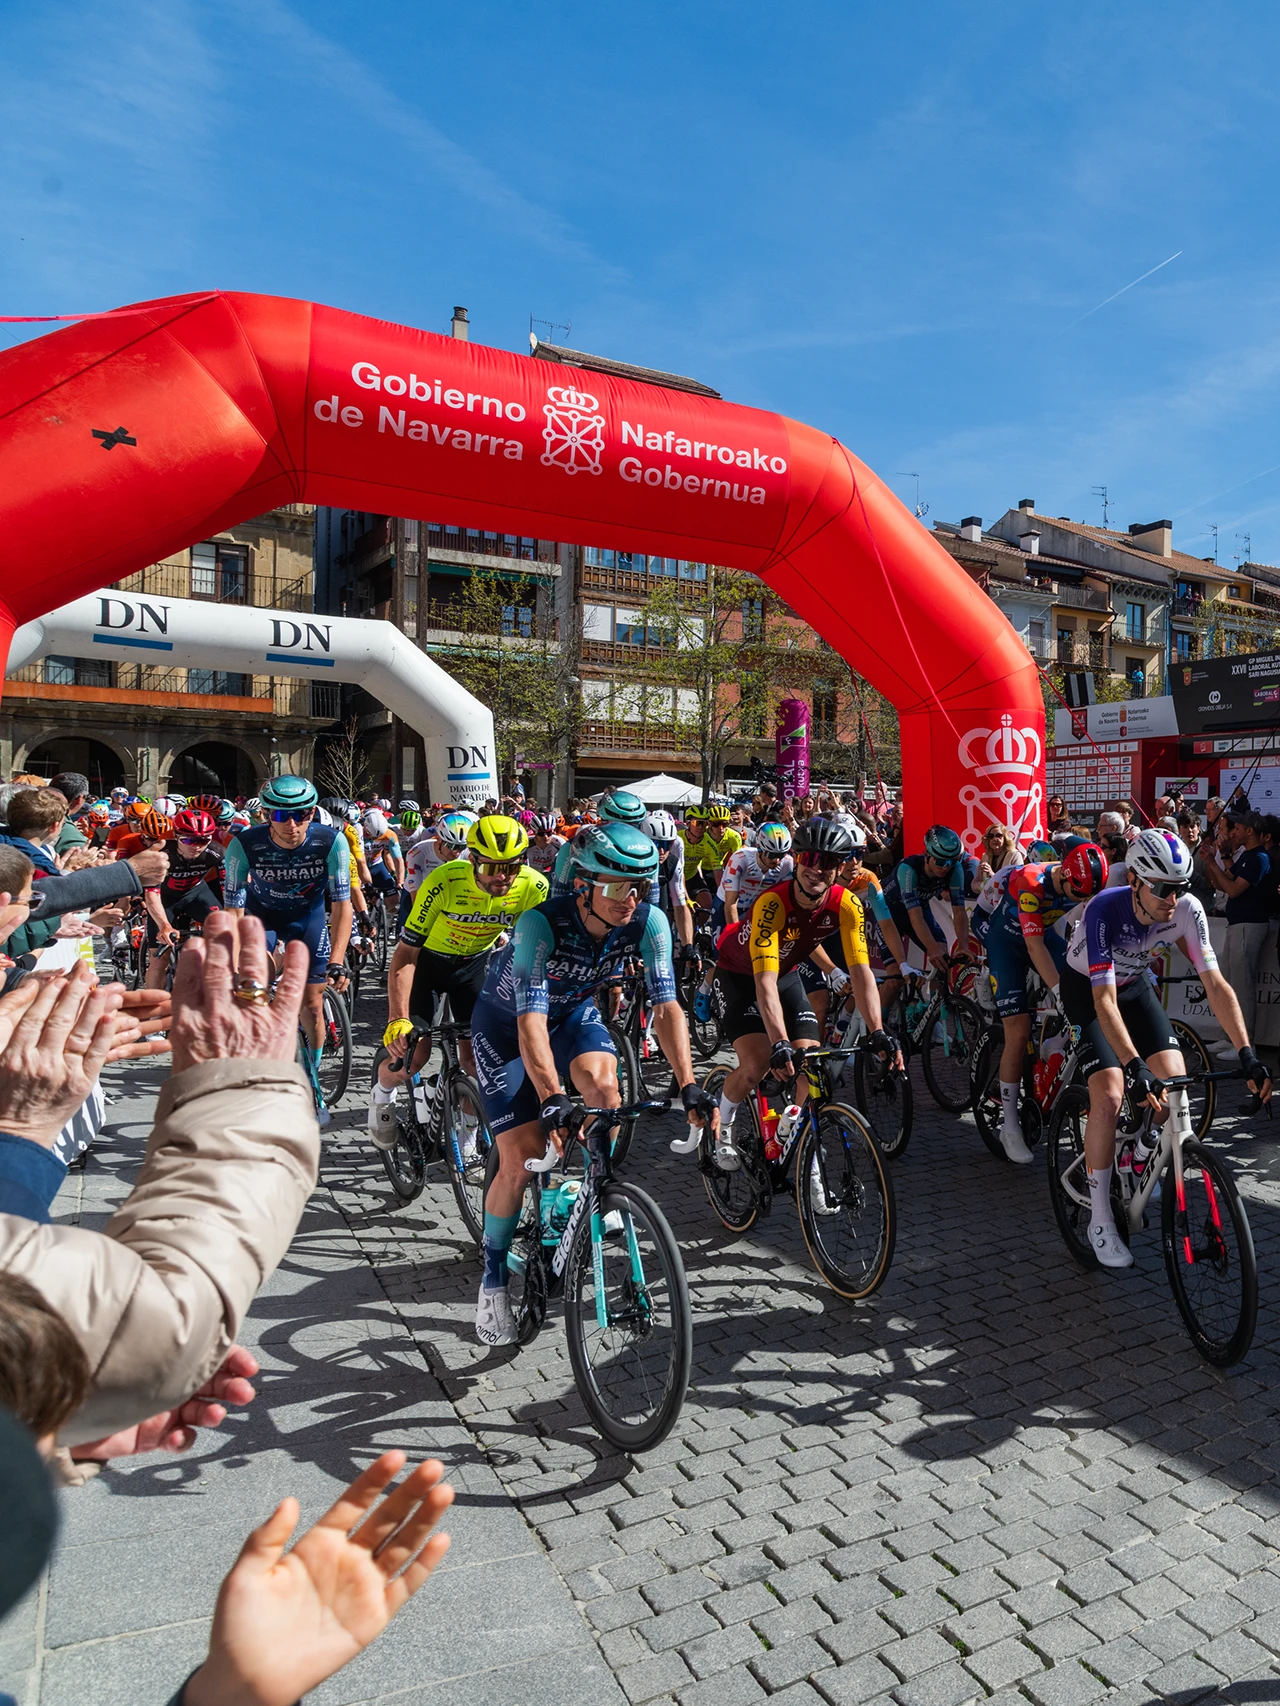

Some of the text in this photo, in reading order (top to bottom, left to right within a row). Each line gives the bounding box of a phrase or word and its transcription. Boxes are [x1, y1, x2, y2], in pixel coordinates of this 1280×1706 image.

[350, 361, 527, 424] Gobierno
[314, 395, 525, 463] de Navarra
[620, 420, 788, 475] Nafarroako
[618, 456, 767, 506] Gobernua
[97, 598, 169, 635] DN
[269, 619, 333, 653] DN
[1248, 663, 1271, 671] LABORAL
[1256, 655, 1274, 663] MIGUEL
[446, 746, 487, 769] DN
[450, 784, 480, 793] DIARIO
[796, 759, 805, 788] kutxa
[450, 793, 492, 803] NAVARRA
[255, 865, 324, 878] BAHRAIN
[1076, 852, 1087, 879] TREK
[417, 882, 444, 923] anicolor
[755, 900, 779, 948] Cofidis
[530, 938, 548, 987] Bianchi
[658, 931, 671, 980] Bianchi
[996, 996, 1018, 1007] EK
[1182, 1004, 1214, 1016] UDA
[472, 1031, 508, 1096] friendly
[480, 1037, 504, 1066] BUSINESS
[970, 1031, 990, 1083] AEOLUS
[476, 1325, 503, 1345] nimbl
